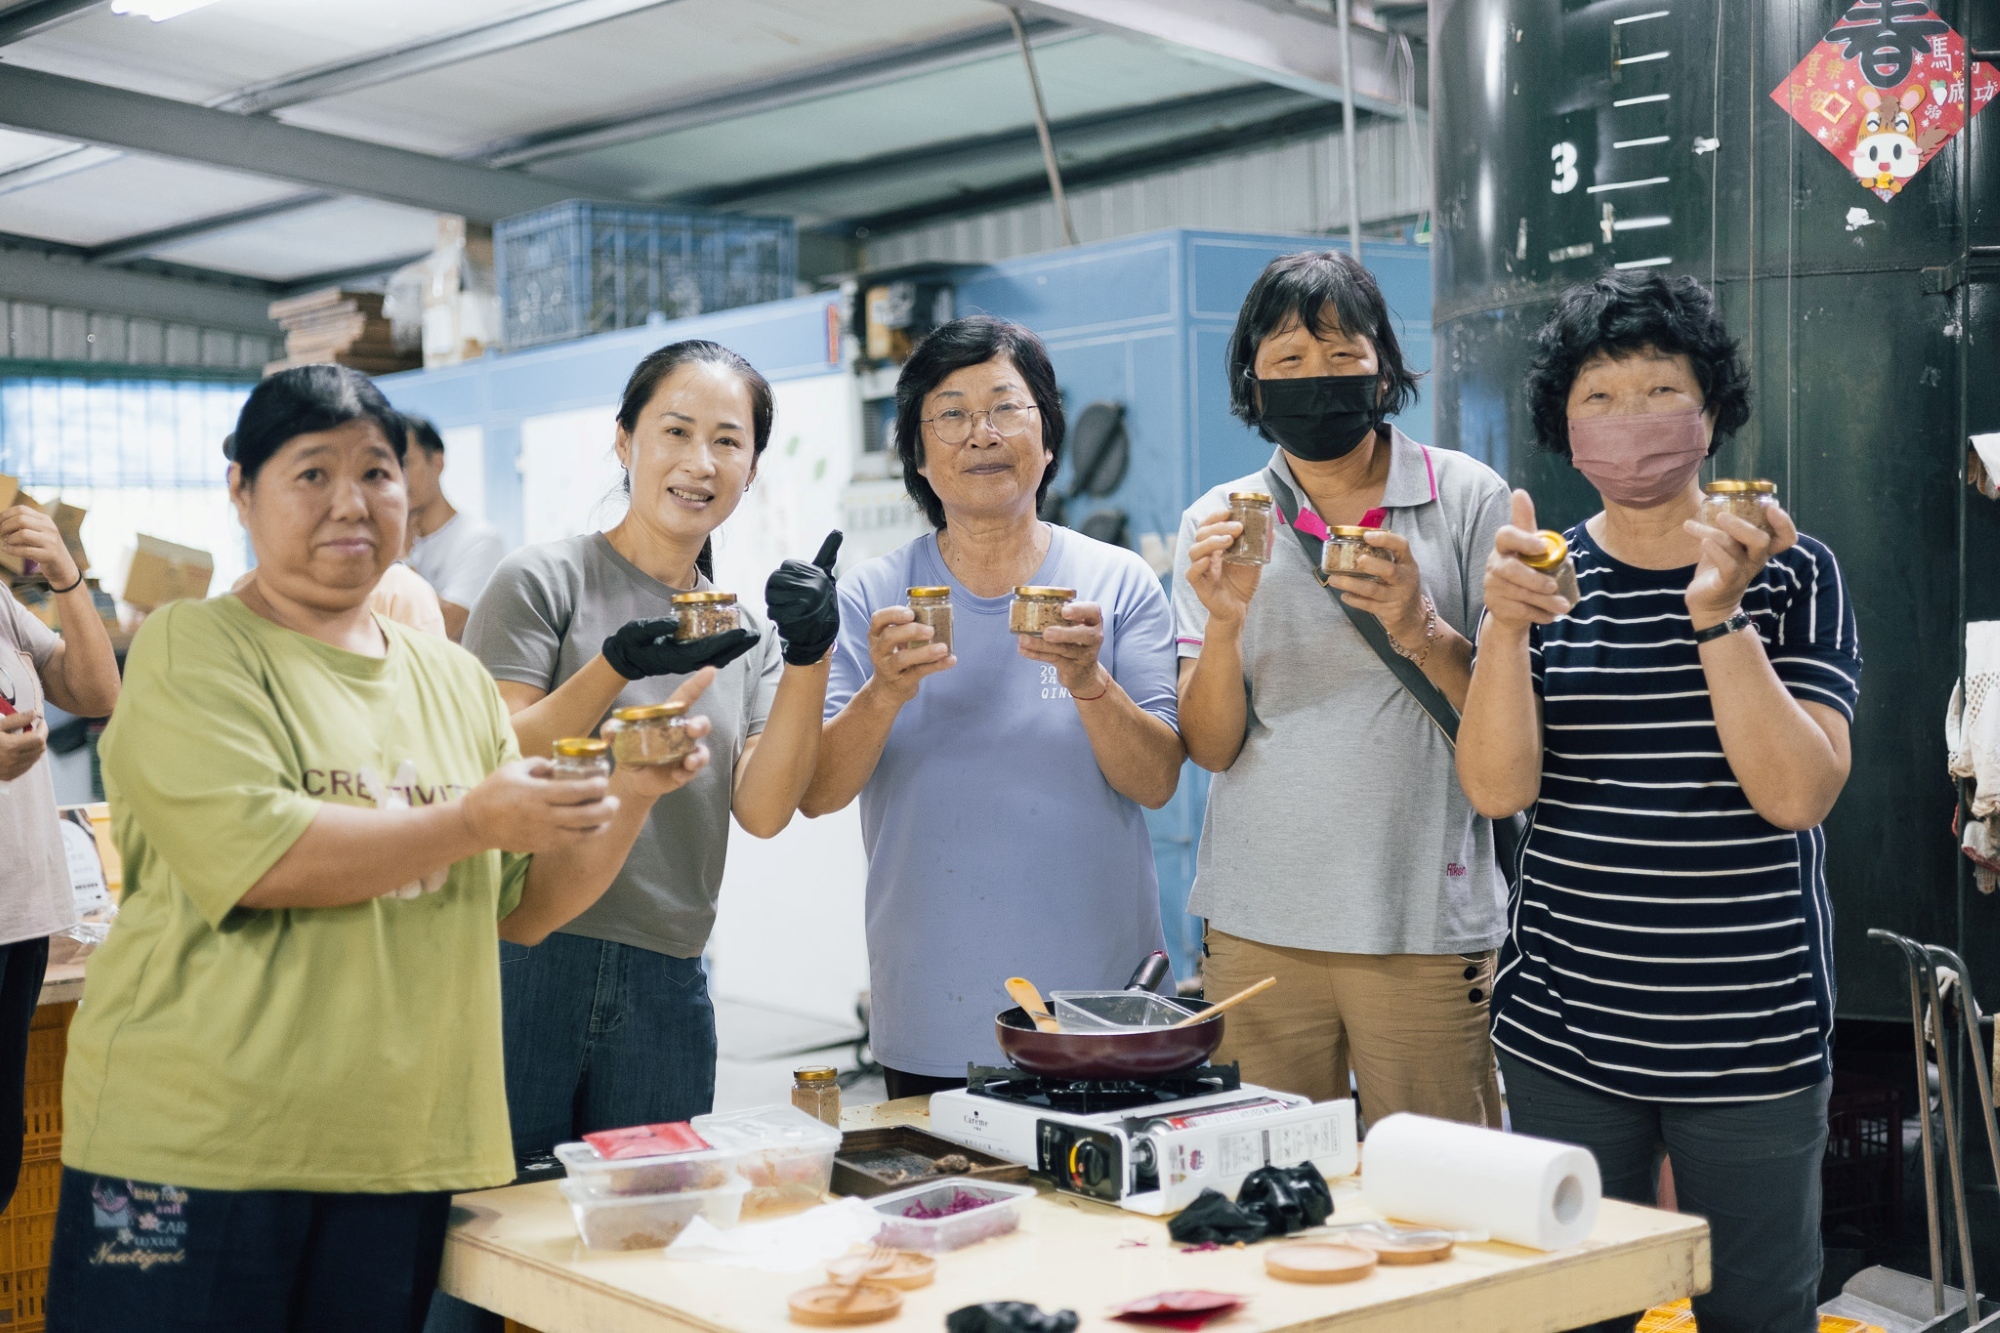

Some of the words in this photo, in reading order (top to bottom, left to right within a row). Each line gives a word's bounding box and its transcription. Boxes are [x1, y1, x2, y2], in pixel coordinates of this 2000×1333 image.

[1551, 141, 1578, 194] 3
[1040, 665, 1057, 676] 20
[1040, 675, 1057, 685] 24
